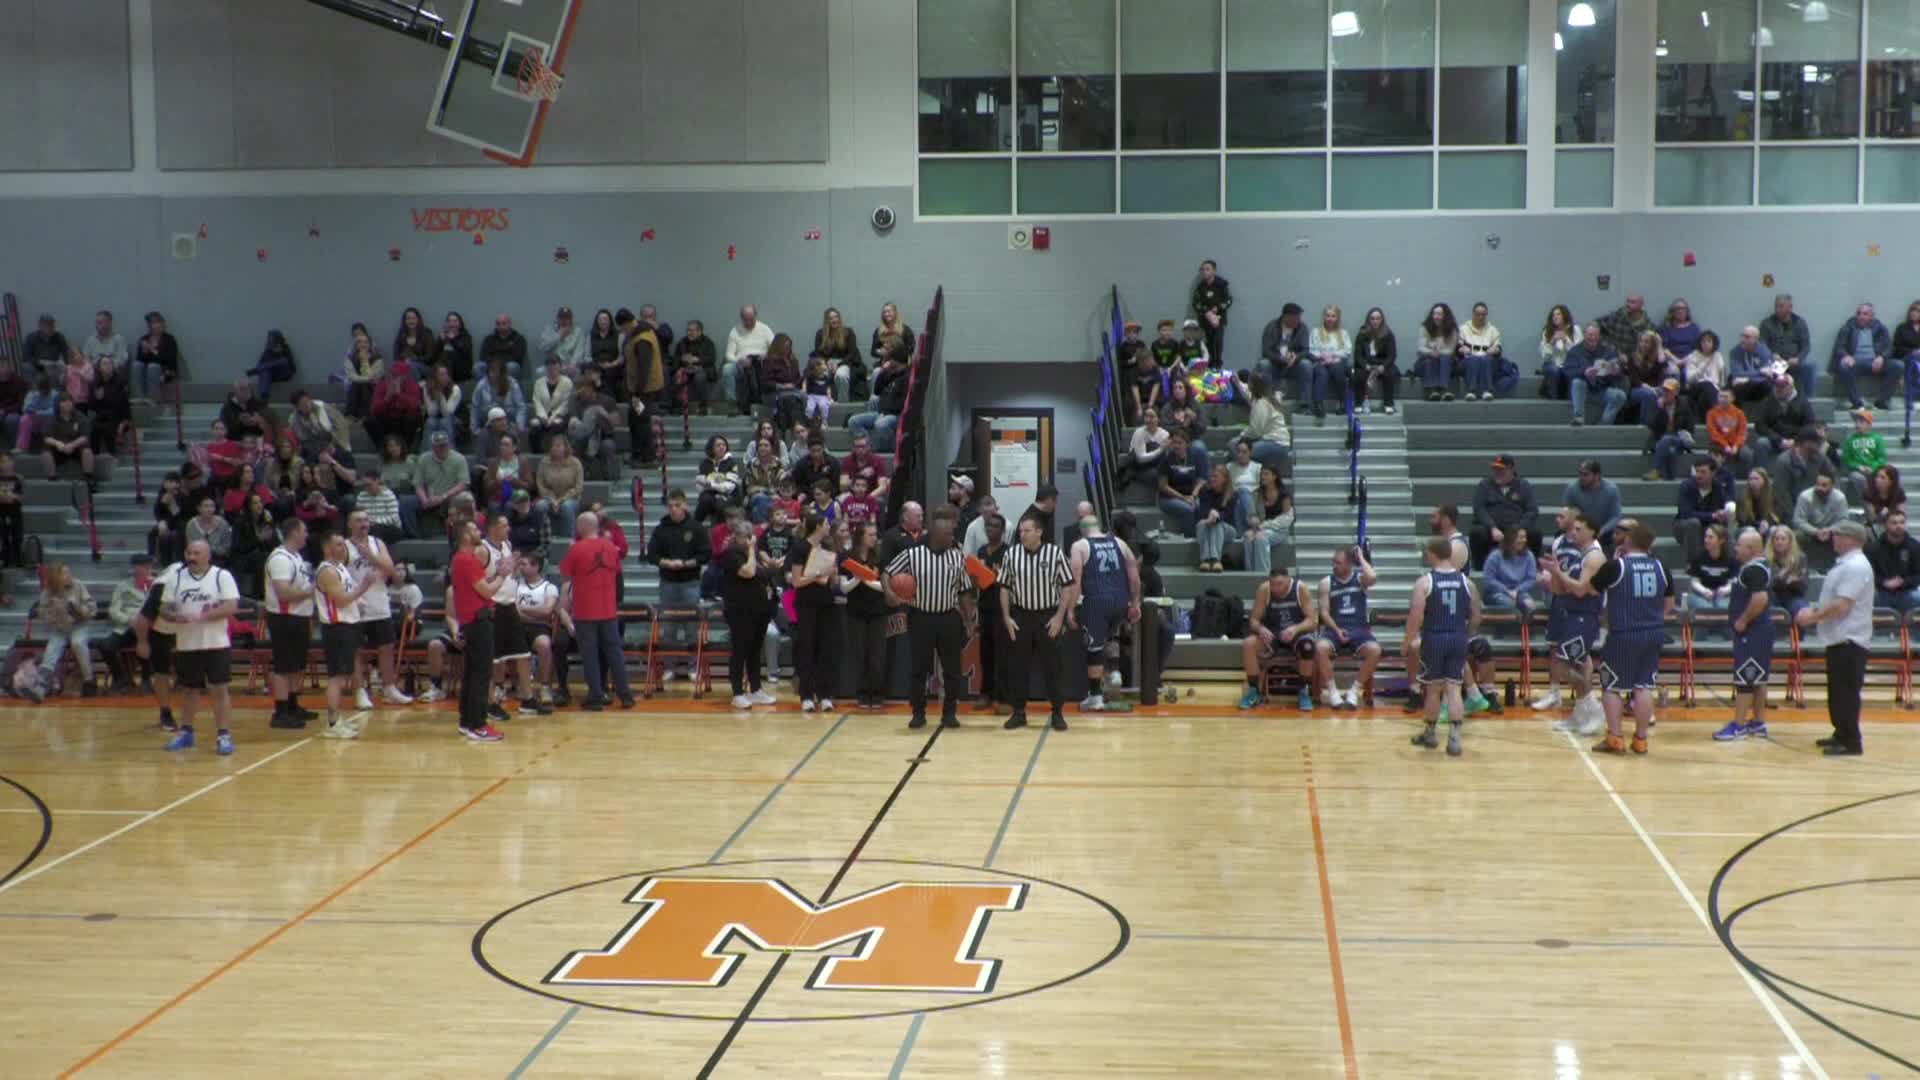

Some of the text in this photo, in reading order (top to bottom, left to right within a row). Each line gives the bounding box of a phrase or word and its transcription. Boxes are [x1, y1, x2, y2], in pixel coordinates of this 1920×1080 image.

[410, 208, 511, 231] VISITORS
[1096, 549, 1120, 573] 24
[1633, 572, 1658, 597] 18
[1441, 590, 1457, 615] 4
[541, 877, 1031, 993] M
